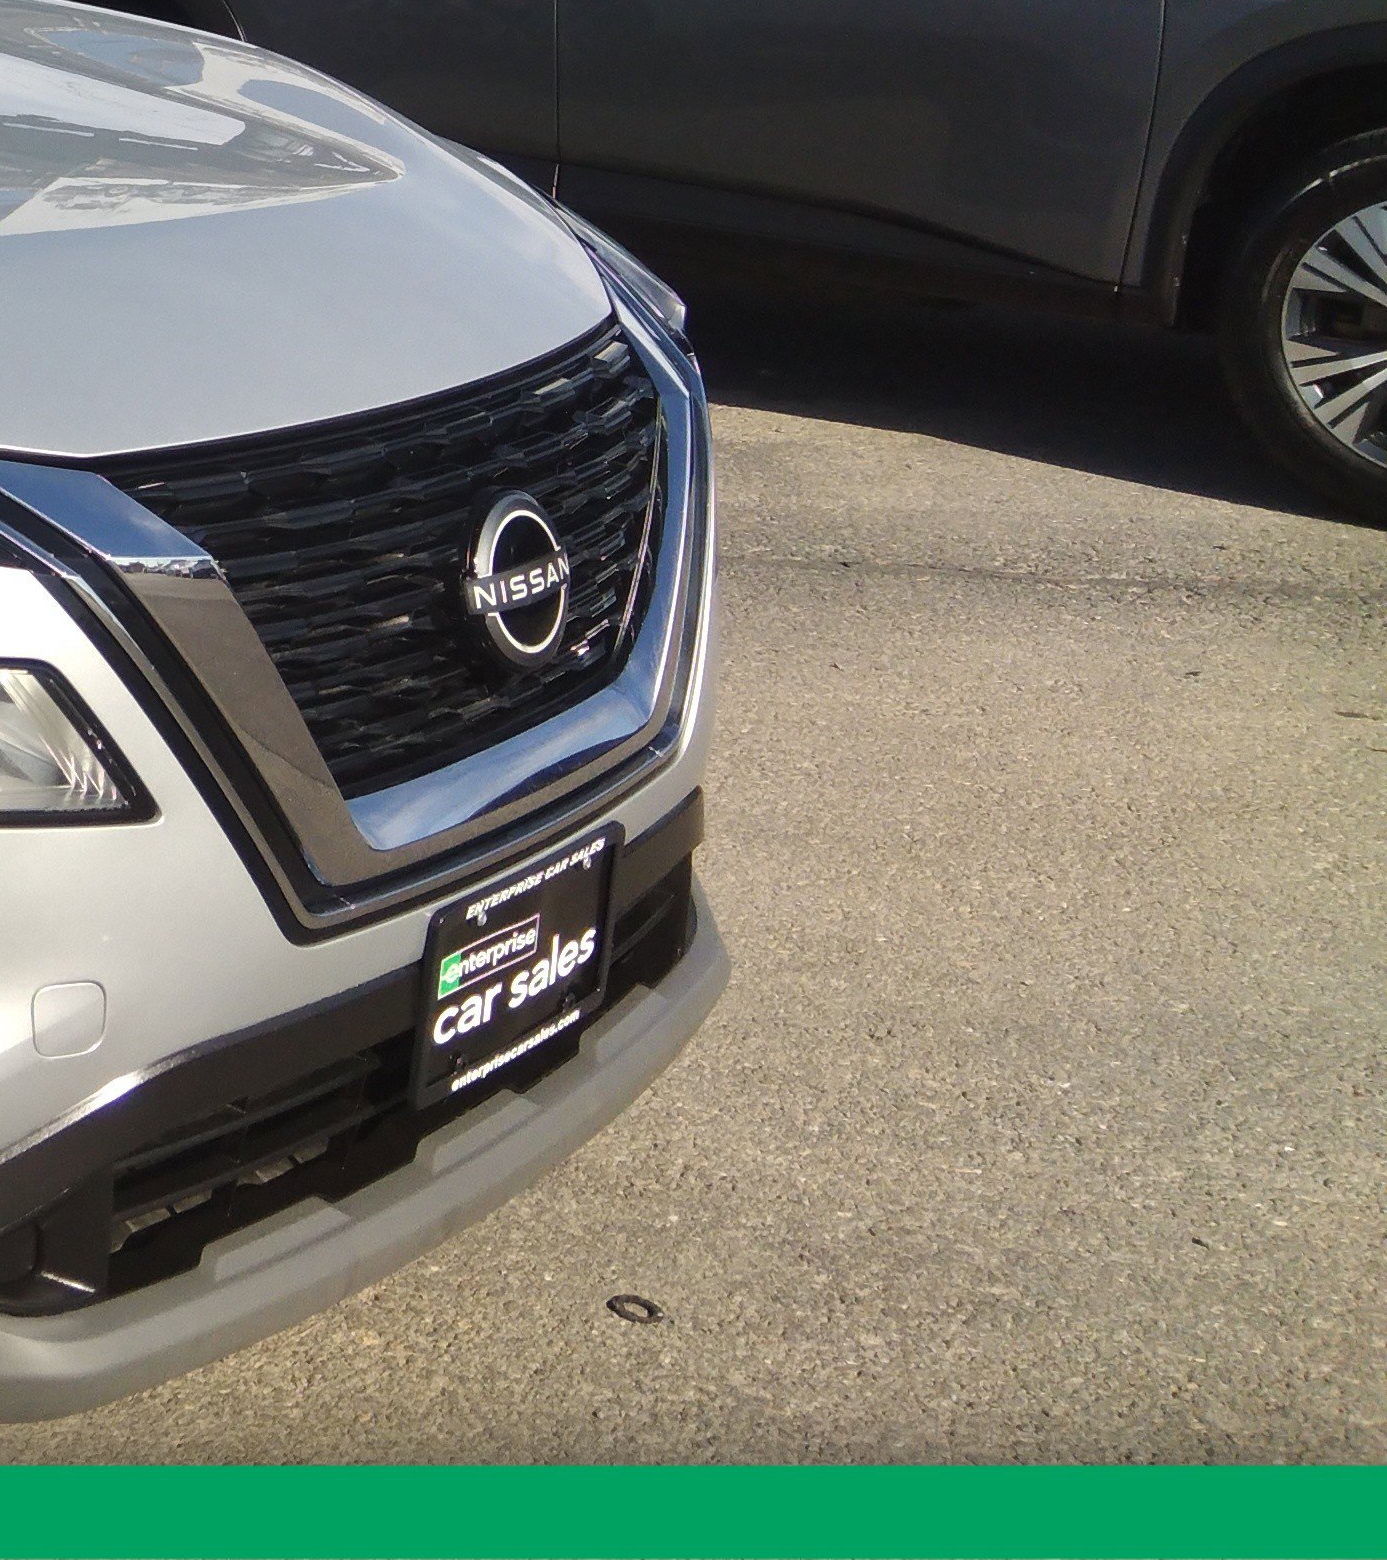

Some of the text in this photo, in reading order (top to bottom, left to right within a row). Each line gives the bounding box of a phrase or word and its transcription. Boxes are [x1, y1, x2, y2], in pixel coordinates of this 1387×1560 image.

[473, 553, 569, 609] NISSAN
[466, 838, 606, 920] ENTERPRISE CAR SALES
[433, 927, 597, 1045] car sales
[441, 927, 537, 983] enterprise
[451, 1008, 581, 1092] enterprisecarsales.com
